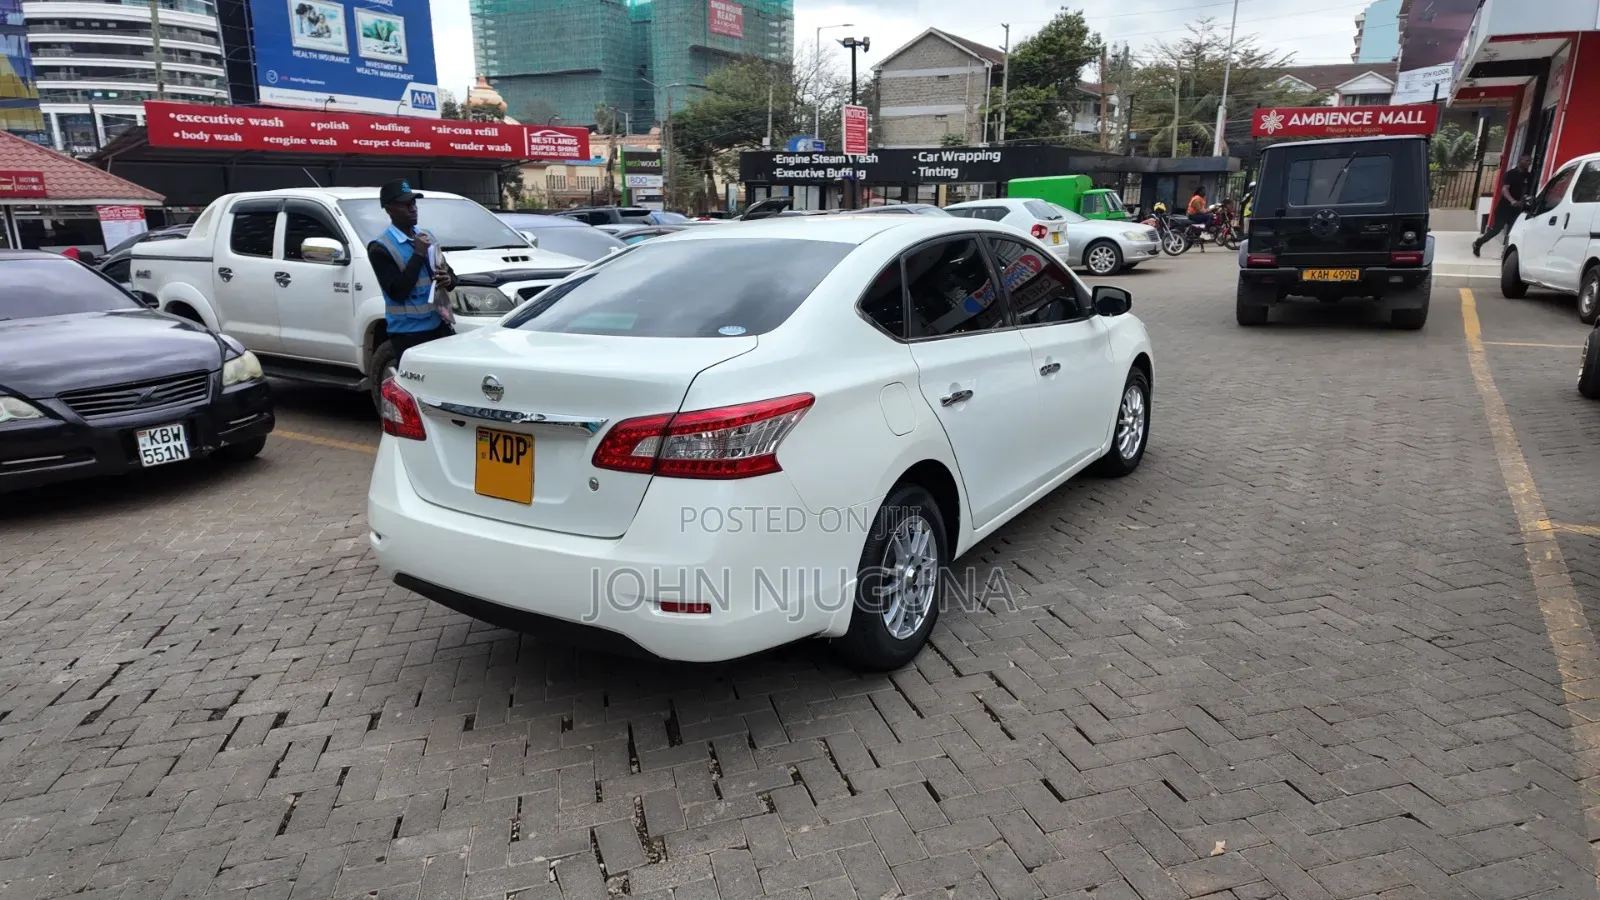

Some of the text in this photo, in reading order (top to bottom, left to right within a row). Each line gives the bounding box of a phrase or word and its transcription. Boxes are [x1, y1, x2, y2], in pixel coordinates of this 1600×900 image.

[717, 10, 736, 22] READY
[292, 50, 350, 64] HEALTH INSURANCE
[365, 61, 398, 71] INVESTMENT
[1433, 68, 1450, 76] FLOOR
[356, 67, 414, 80] WEALTH MANAGEMENT
[413, 91, 435, 105] APA
[845, 108, 866, 119] NOTICE
[1288, 111, 1426, 126] AMBIENCE MALL
[176, 113, 284, 128] executive wash
[317, 121, 349, 131] polish
[375, 122, 411, 134] buffing
[436, 126, 499, 137] air-con refill
[181, 130, 242, 143] body wash
[269, 136, 337, 146] engine wash
[531, 136, 578, 145] WESTLANDS
[358, 139, 431, 150] carpet cleaning
[455, 142, 512, 152] under wash
[557, 145, 579, 153] SHINE
[776, 154, 810, 166] Engine
[812, 154, 846, 164] Steam
[918, 150, 1001, 165] Car Wrapping
[776, 168, 825, 178] Executive
[918, 166, 958, 179] Tinting
[1311, 270, 1357, 280] KAH 499G
[149, 426, 181, 446] KBW
[142, 443, 186, 464] 551N
[489, 432, 528, 466] KDP
